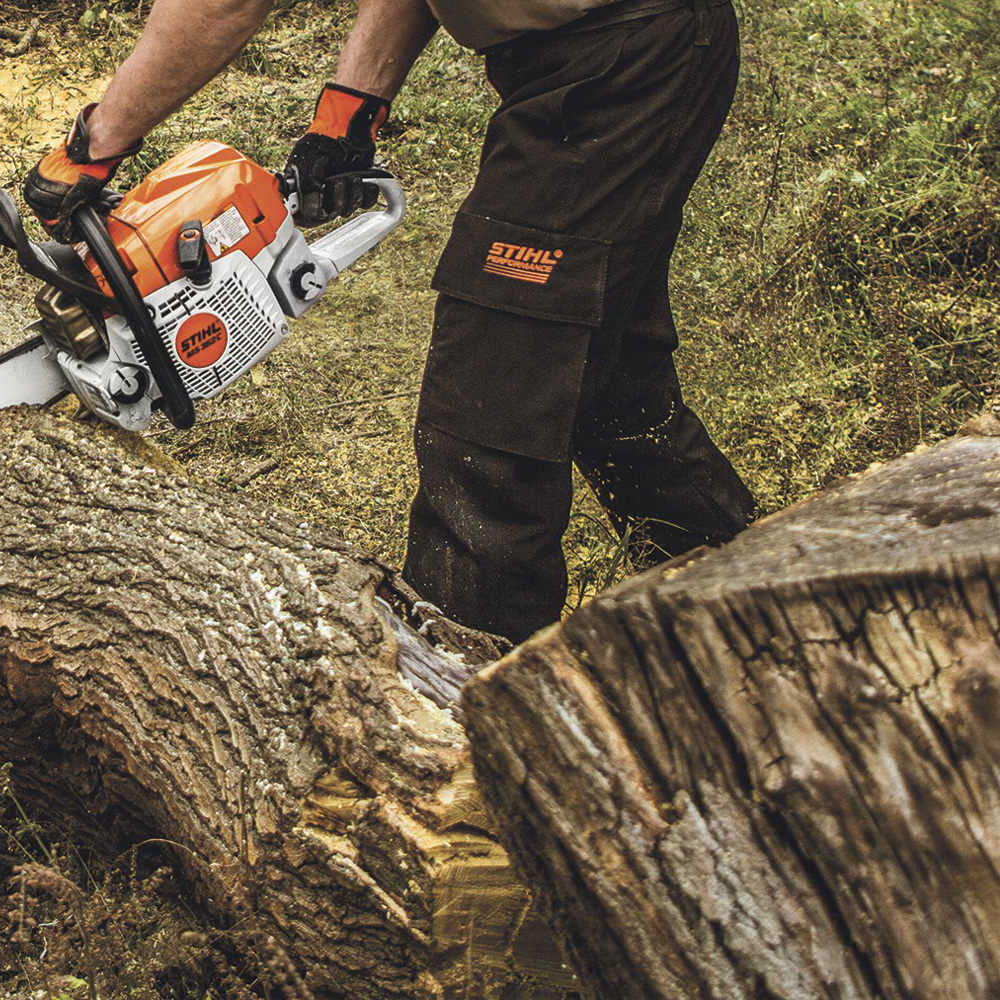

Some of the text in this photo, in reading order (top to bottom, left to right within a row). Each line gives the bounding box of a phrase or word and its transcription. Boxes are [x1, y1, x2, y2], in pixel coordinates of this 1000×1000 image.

[486, 254, 553, 273] PERFORMANCE
[181, 322, 222, 353] STIHL
[186, 345, 201, 359] MS
